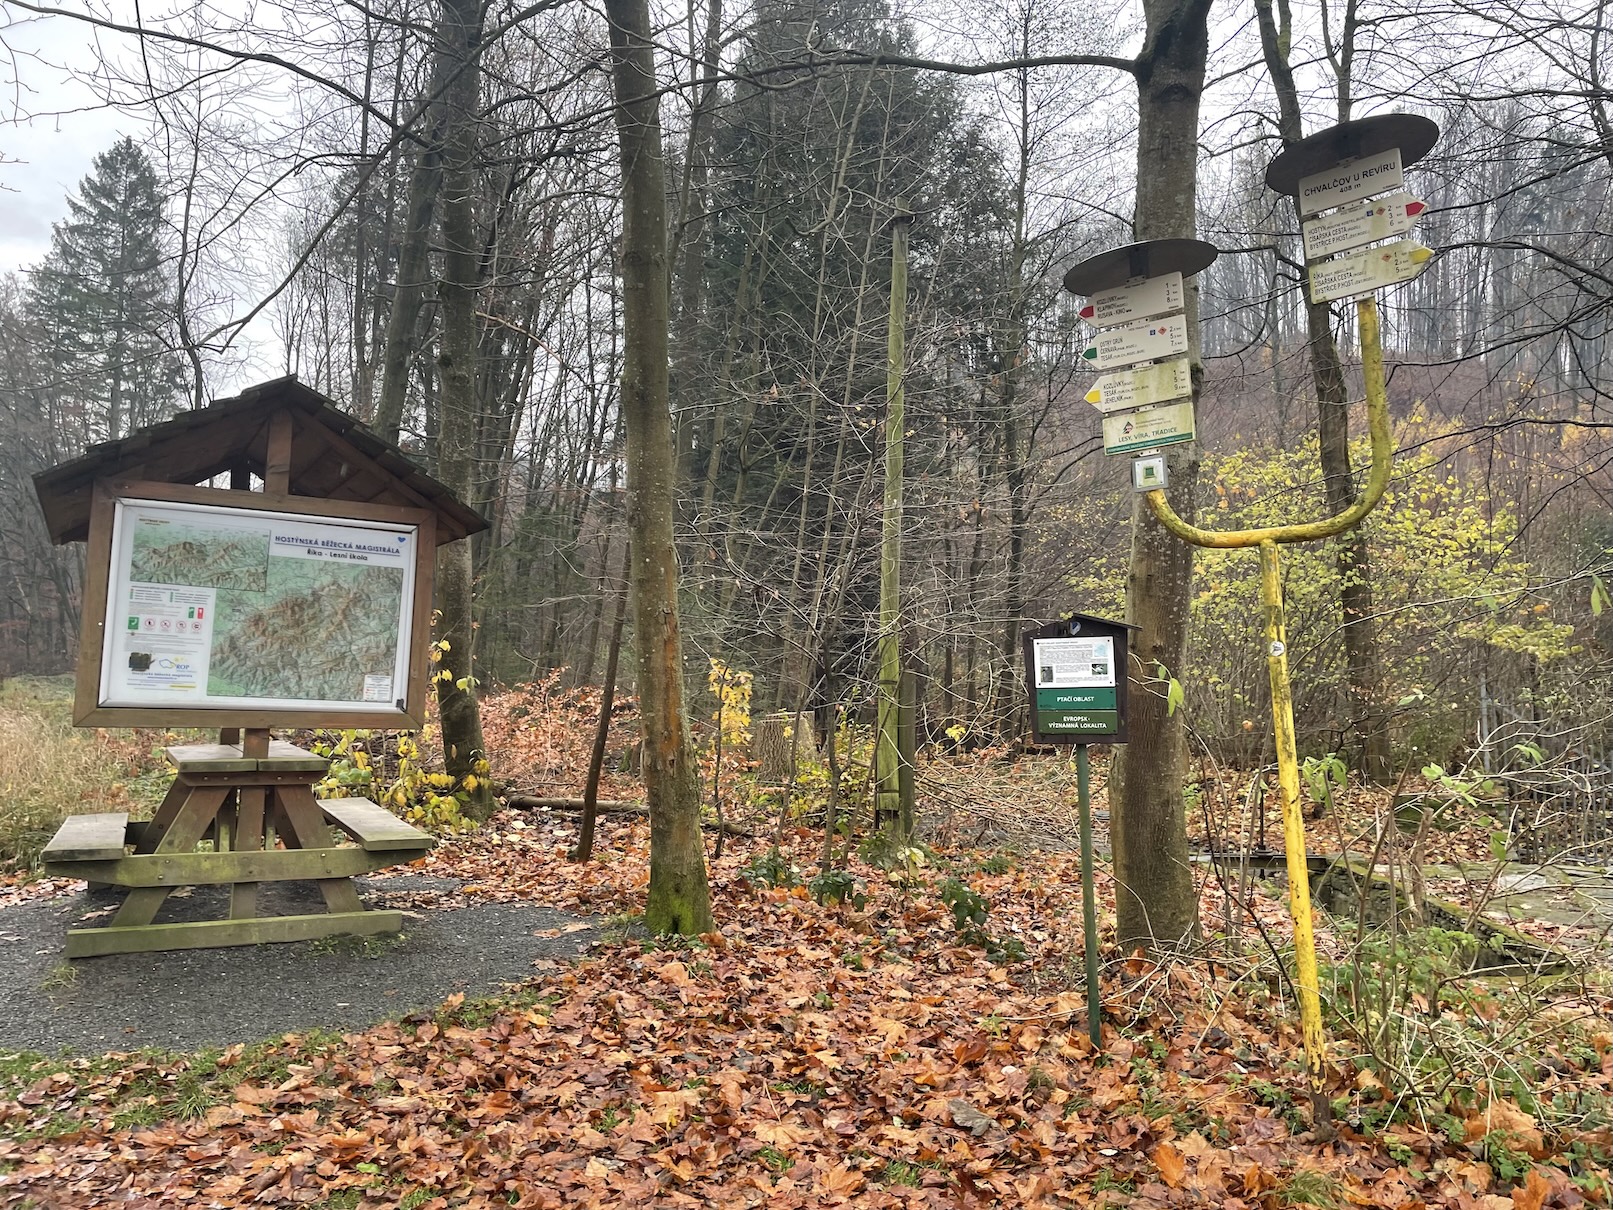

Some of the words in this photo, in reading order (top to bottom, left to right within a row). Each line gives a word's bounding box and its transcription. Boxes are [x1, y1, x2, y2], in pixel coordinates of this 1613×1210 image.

[1304, 176, 1351, 197] CHVALČOV
[1353, 173, 1360, 181] U
[1362, 162, 1396, 179] REVÍRU
[1339, 185, 1353, 193] 408
[1332, 226, 1347, 235] CESTA
[1338, 272, 1352, 281] CESTA
[1134, 431, 1150, 440] VÍRA,
[1152, 427, 1178, 436] TRADICE
[275, 535, 319, 546] HOSTÝNSKÁ
[321, 540, 353, 550] BĚŽECKÁ
[356, 544, 400, 554] MAGISTRÁLA
[330, 551, 348, 559] Lesní
[349, 553, 368, 561] škola
